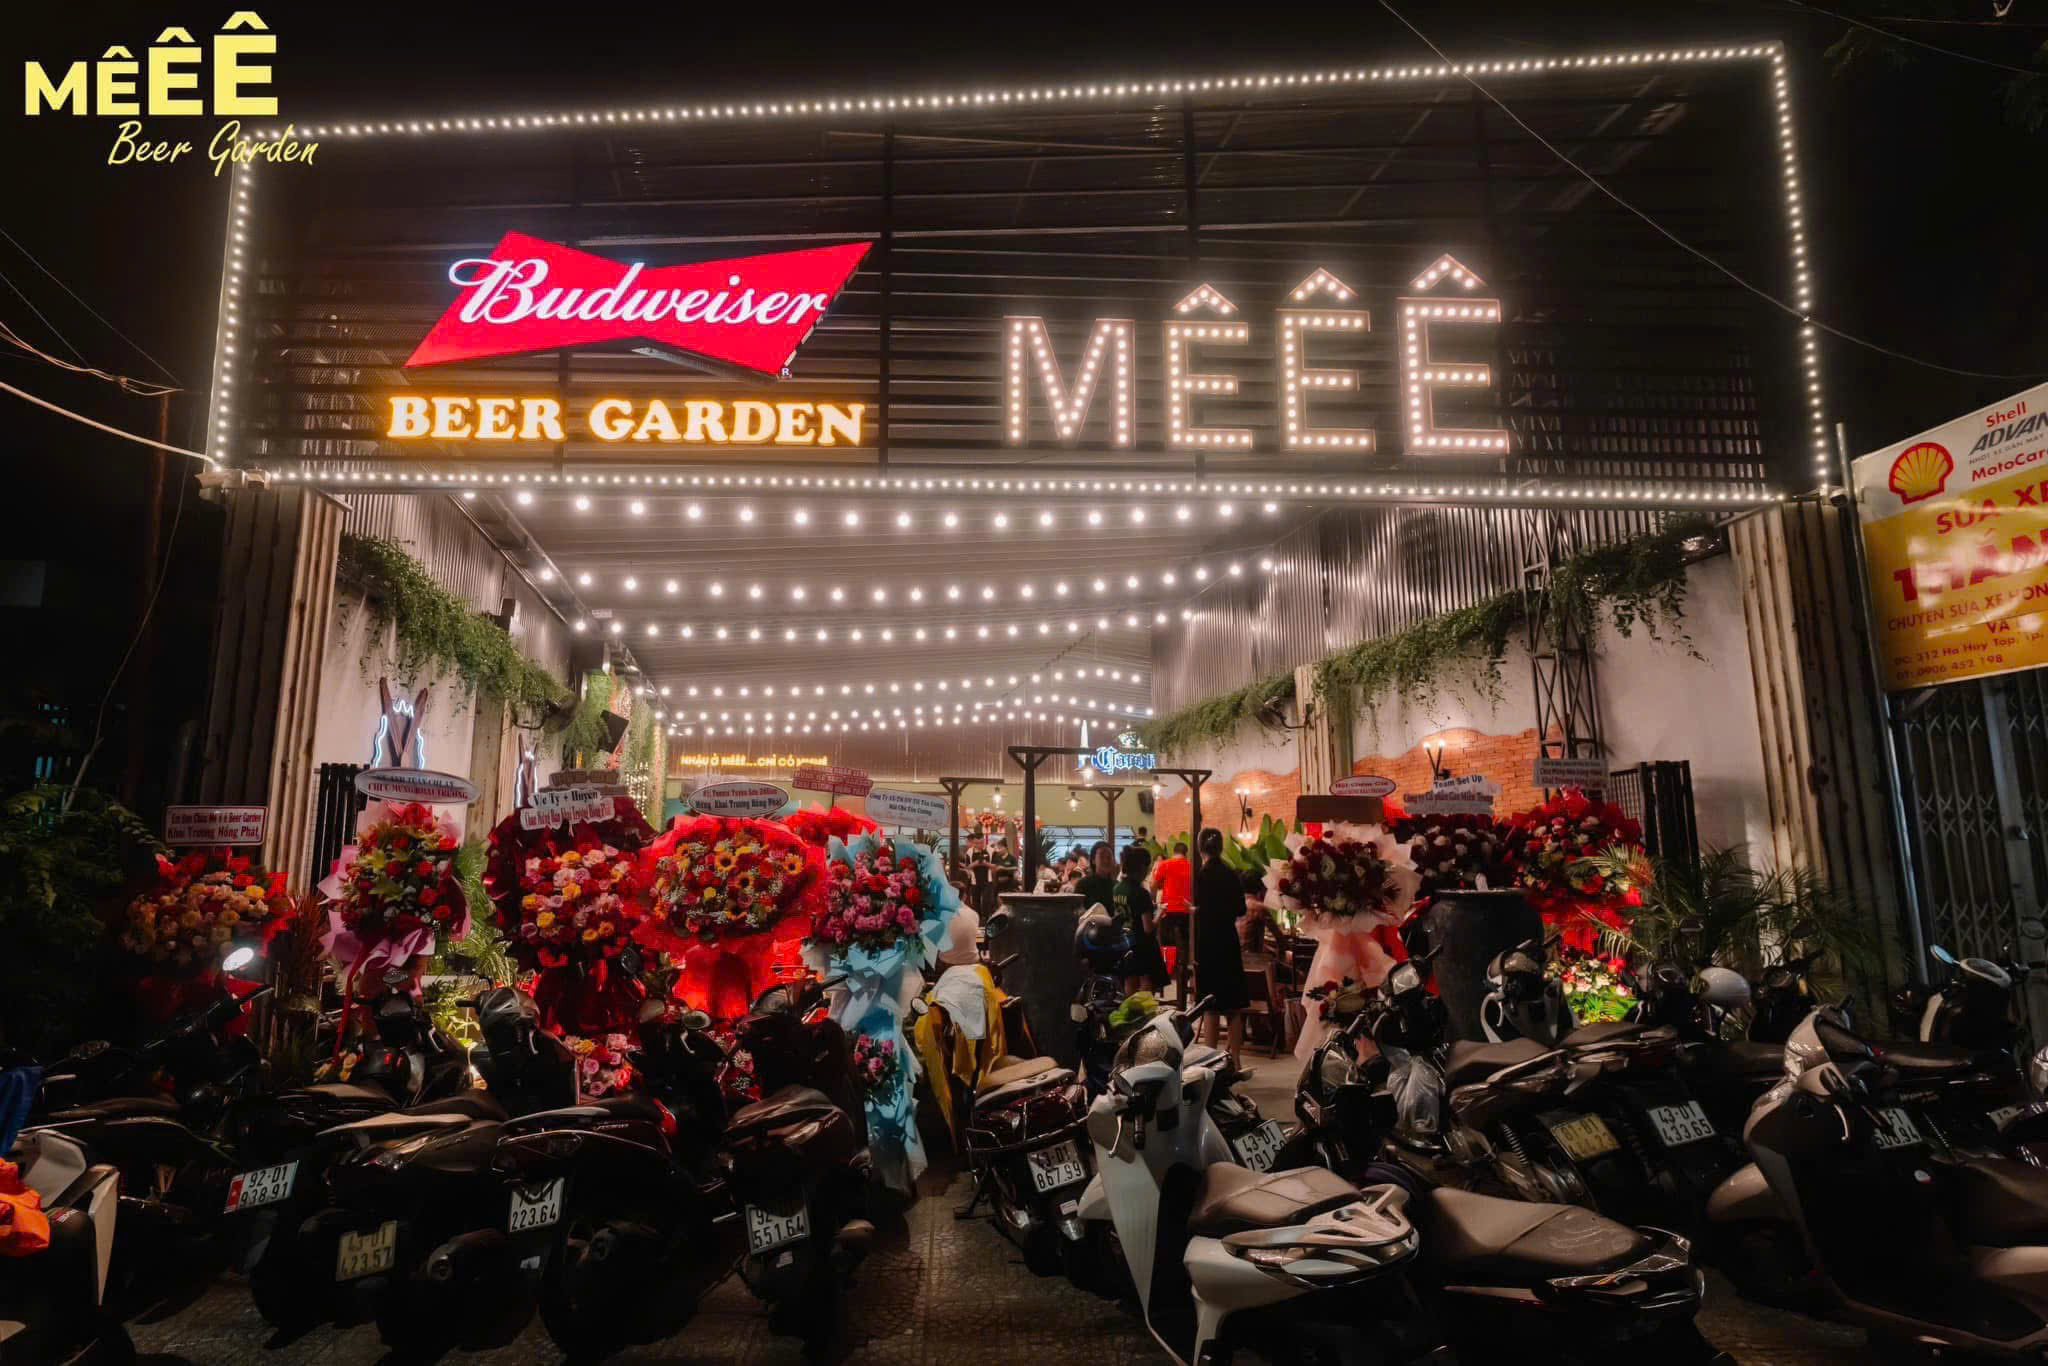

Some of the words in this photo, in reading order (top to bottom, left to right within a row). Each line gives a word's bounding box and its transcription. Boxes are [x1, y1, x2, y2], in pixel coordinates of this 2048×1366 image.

[448, 257, 828, 324] Budweiser
[1002, 254, 1510, 454] MÊÊÊ
[387, 397, 565, 440] BEER
[588, 399, 866, 447] GARDEN
[1986, 401, 2027, 427] Shell
[1972, 448, 2048, 482] MotoCar
[1090, 746, 1156, 776] Coron
[1036, 1160, 1082, 1190] 867.99
[511, 1203, 557, 1231] 223.64
